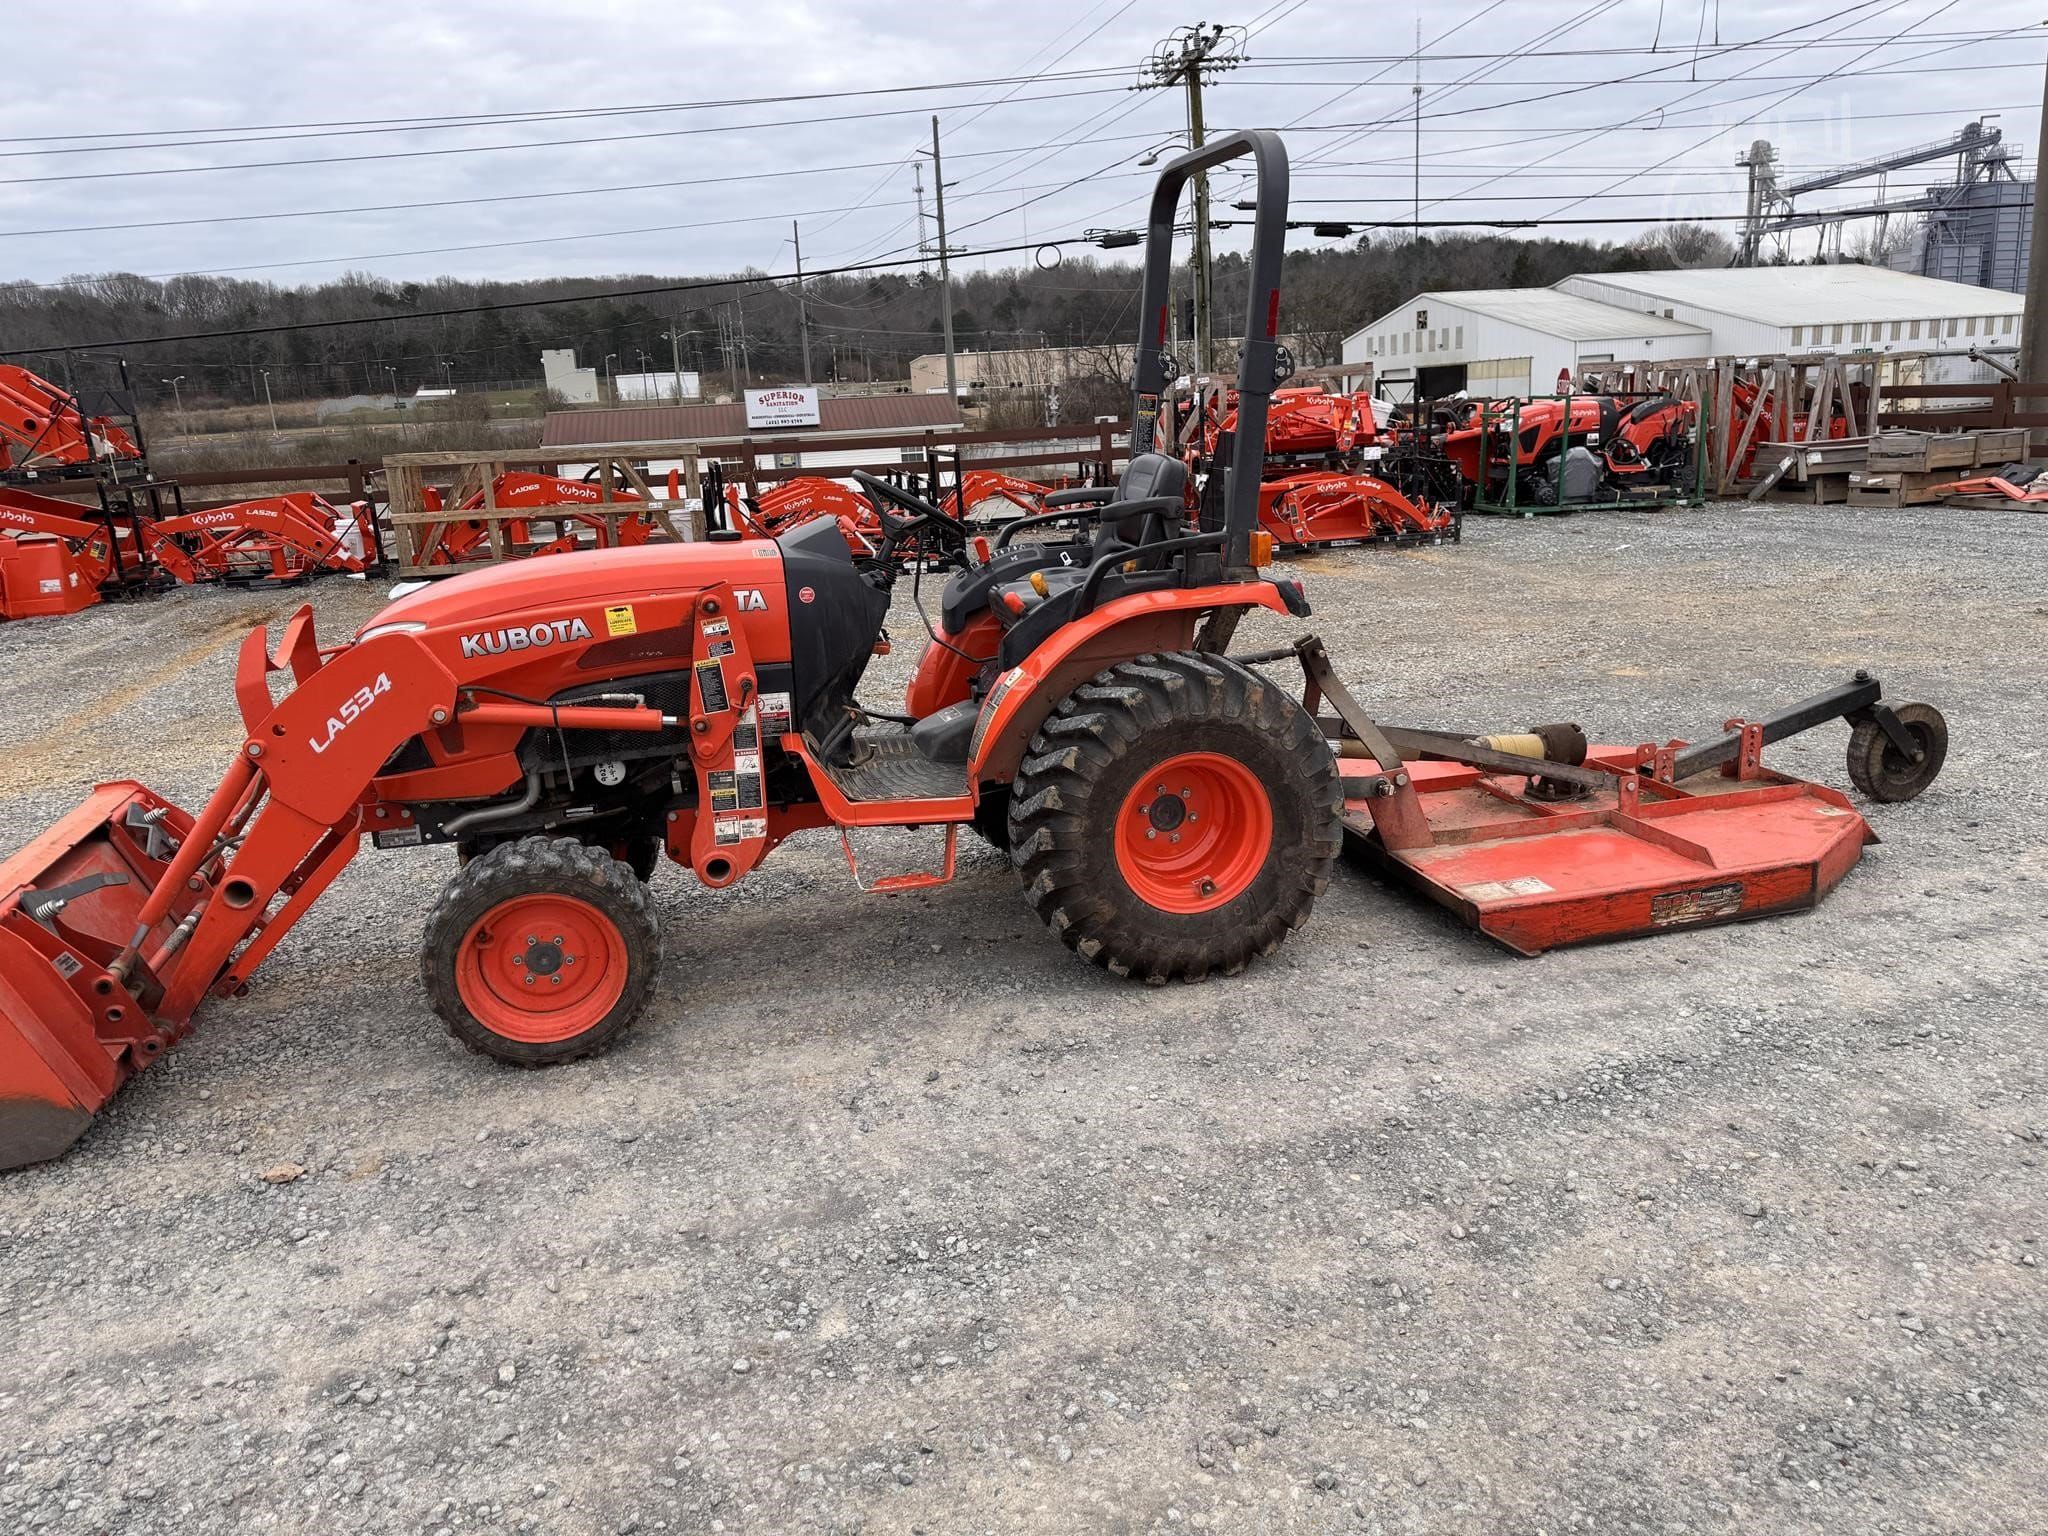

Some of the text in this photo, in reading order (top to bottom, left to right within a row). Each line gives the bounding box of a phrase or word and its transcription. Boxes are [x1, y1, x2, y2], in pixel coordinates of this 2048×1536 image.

[758, 391, 805, 405] SUPERIOR
[1307, 396, 1335, 406] Kubota
[556, 483, 597, 499] Kubota
[1005, 478, 1028, 490] Kubota
[1317, 480, 1347, 492] Kubota
[783, 497, 813, 510] Kubota
[192, 511, 235, 525] Kubota
[460, 616, 594, 659] KUBOTA
[308, 671, 392, 753] LA534
